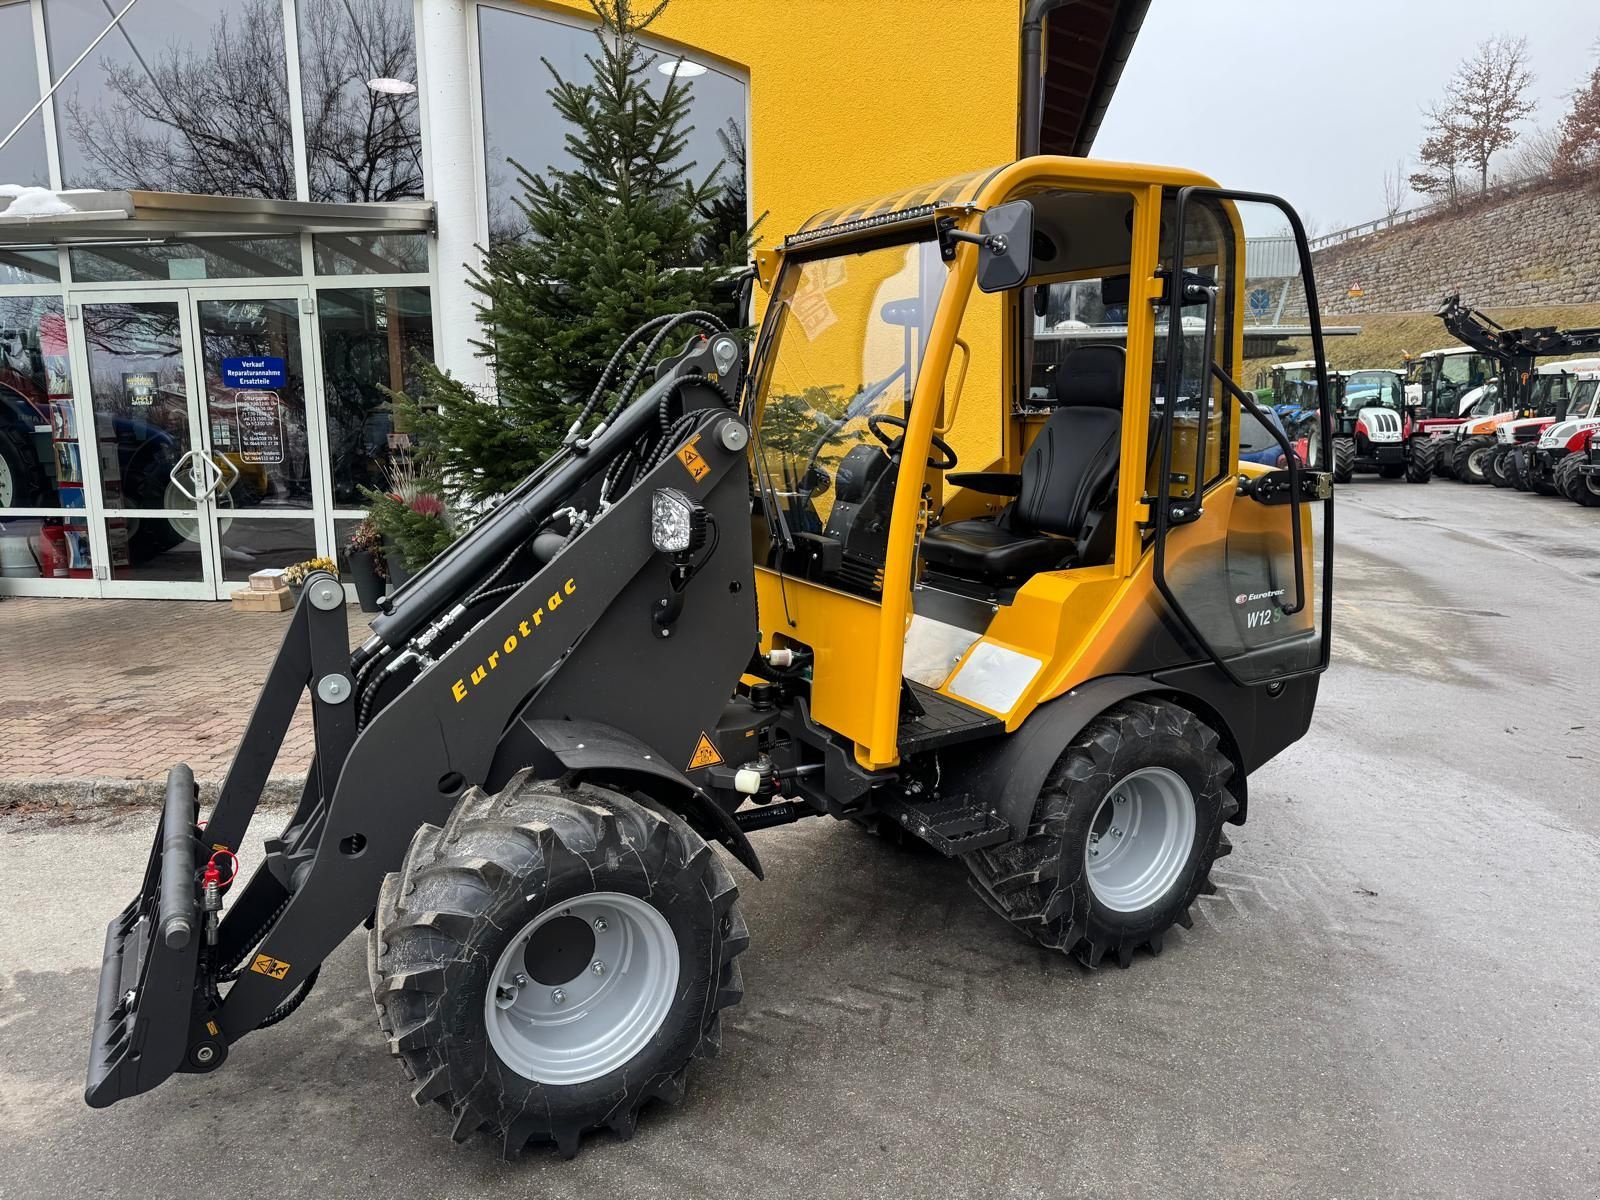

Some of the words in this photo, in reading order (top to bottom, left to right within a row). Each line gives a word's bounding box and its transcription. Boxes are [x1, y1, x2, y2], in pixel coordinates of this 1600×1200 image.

[227, 369, 281, 377] Reparaturannahme
[1248, 589, 1285, 601] Eurotrac
[451, 578, 577, 703] Eurotrac
